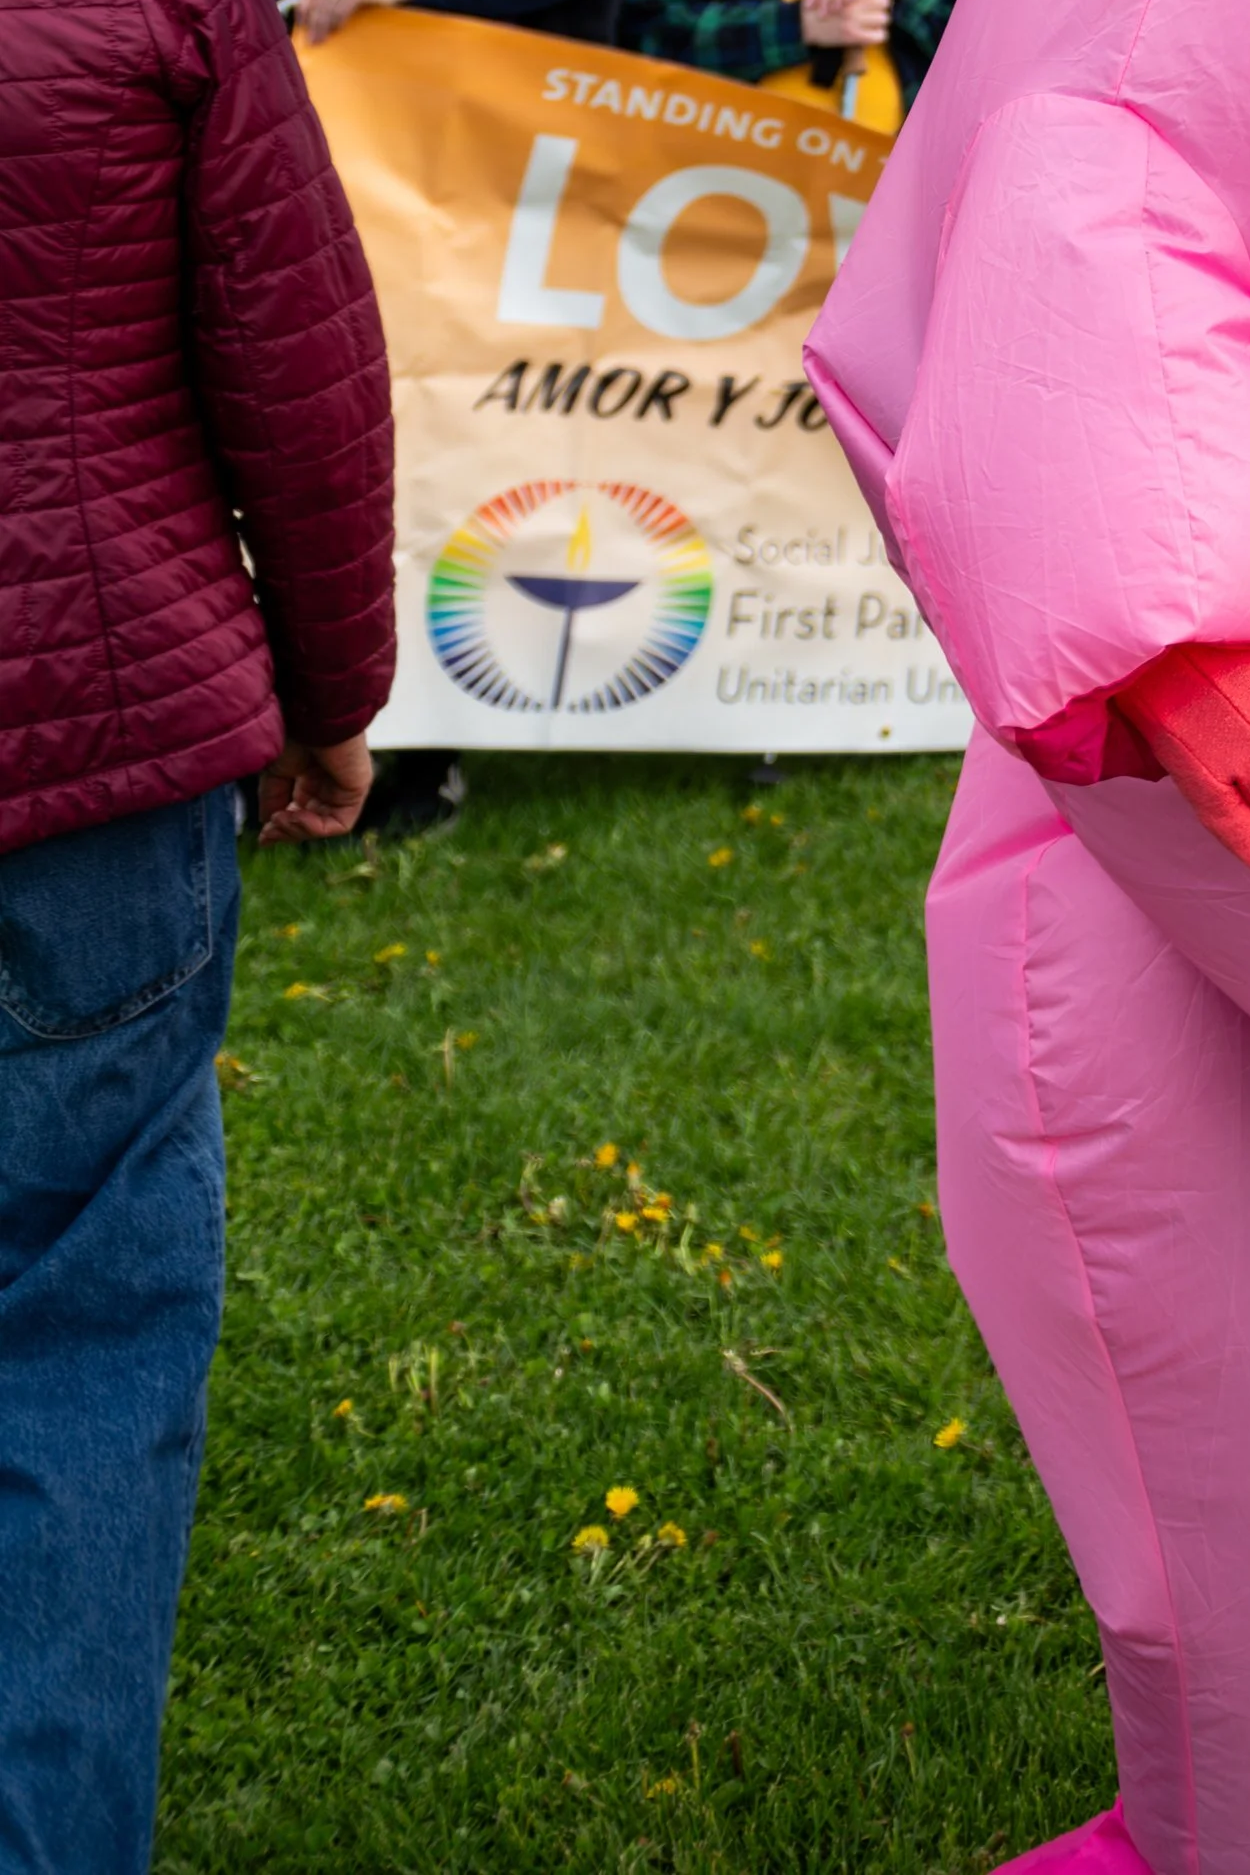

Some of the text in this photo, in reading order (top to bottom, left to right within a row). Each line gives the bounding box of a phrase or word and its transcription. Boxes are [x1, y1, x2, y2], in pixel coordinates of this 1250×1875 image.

[541, 68, 867, 174] STANDING ON
[472, 357, 690, 421] AMOR
[708, 374, 757, 428] Y
[733, 525, 847, 567] Social
[726, 589, 838, 640] First
[715, 665, 894, 705] Unitarian
